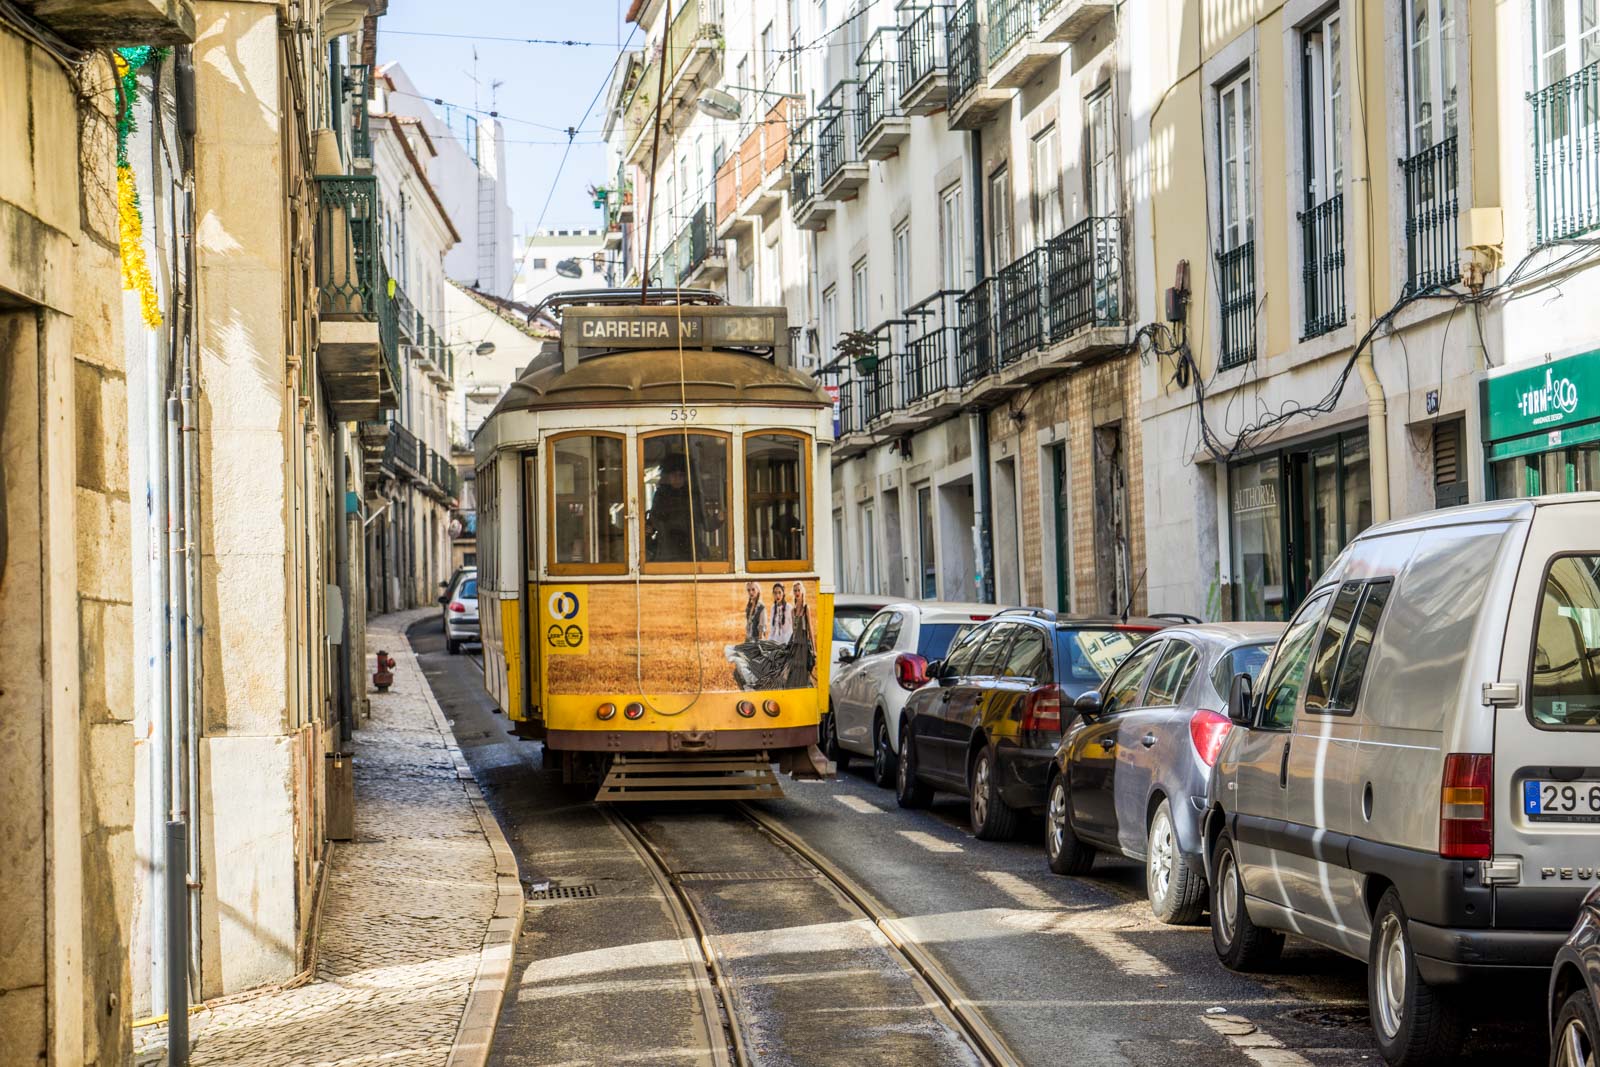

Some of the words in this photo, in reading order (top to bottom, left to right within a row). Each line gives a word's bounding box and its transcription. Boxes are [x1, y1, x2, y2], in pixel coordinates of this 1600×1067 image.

[582, 320, 670, 338] CARREIRA
[670, 409, 698, 421] 559
[1233, 483, 1276, 510] AUTHORYA
